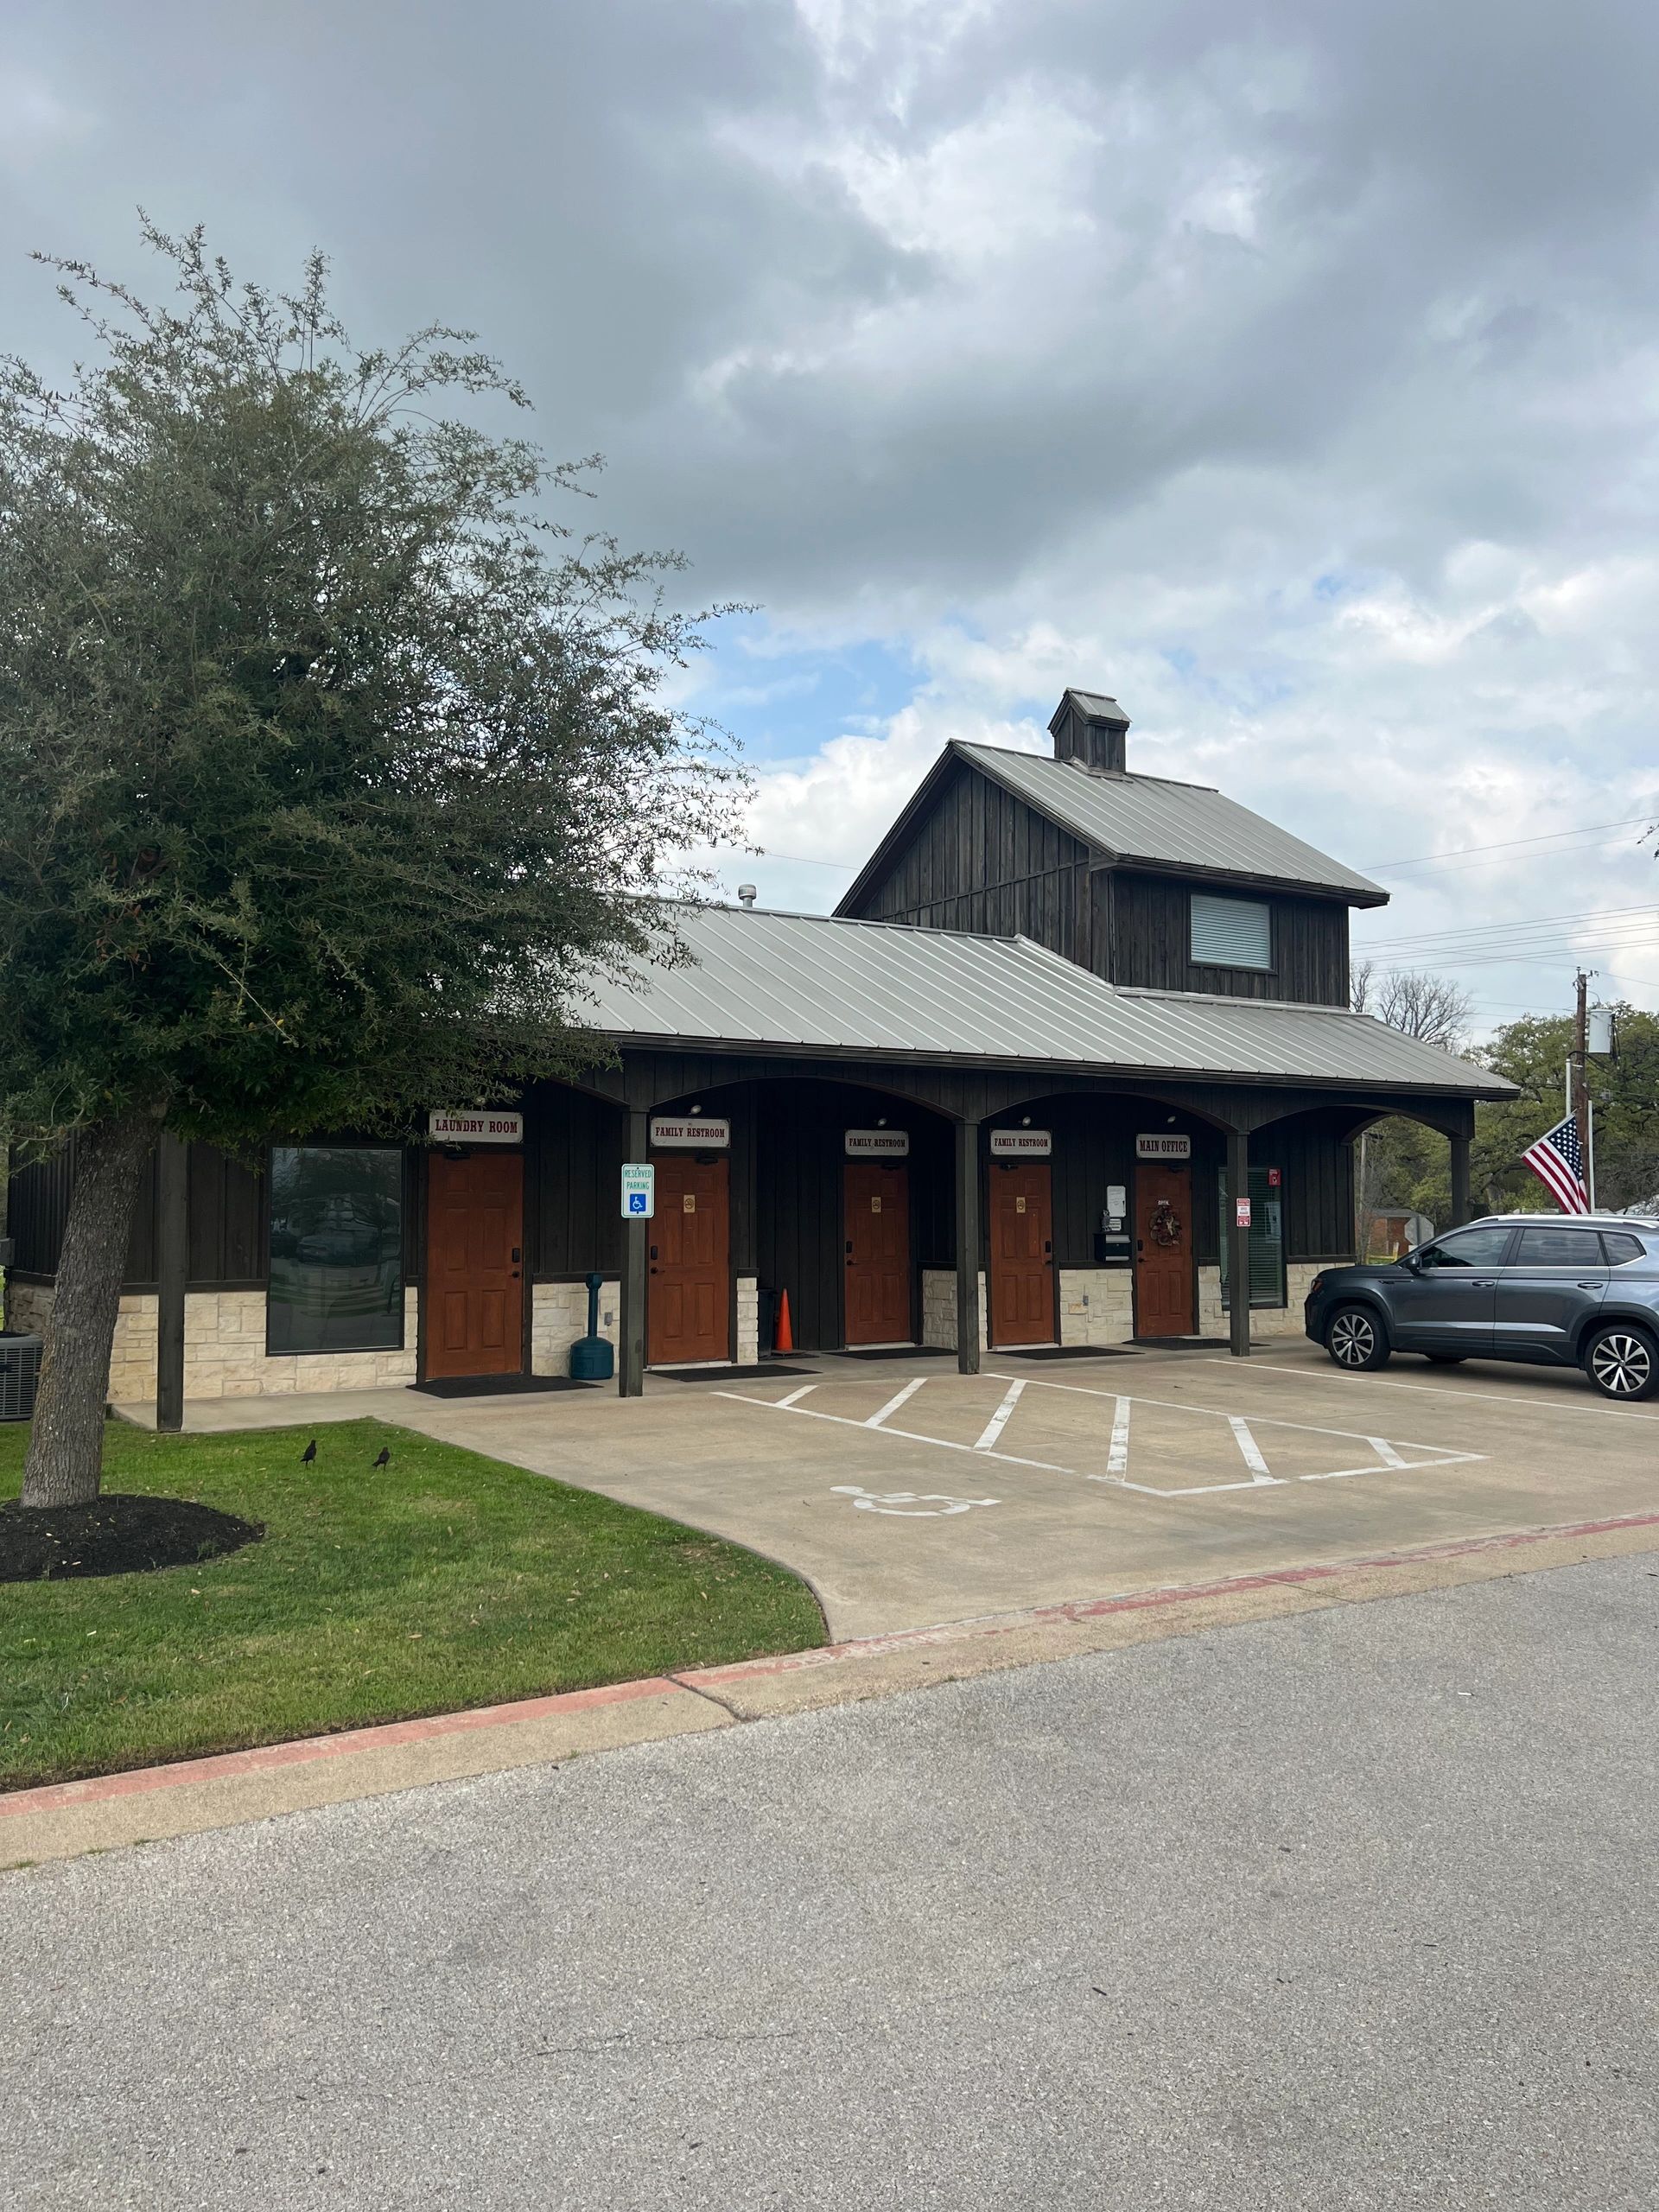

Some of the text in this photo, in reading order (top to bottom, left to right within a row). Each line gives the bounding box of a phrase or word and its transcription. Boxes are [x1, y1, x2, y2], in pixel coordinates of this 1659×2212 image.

[435, 1119, 518, 1134] LAUNDRY ROOM
[655, 1127, 725, 1138] FAMILY RESTROOM
[849, 1138, 906, 1147] FAMILY RESTROOM
[994, 1138, 1048, 1147] FAMILY RESTROOM
[1140, 1141, 1188, 1153] MAIN OFFICE
[624, 1169, 652, 1179] RESERVED
[626, 1181, 650, 1190] PARKING
